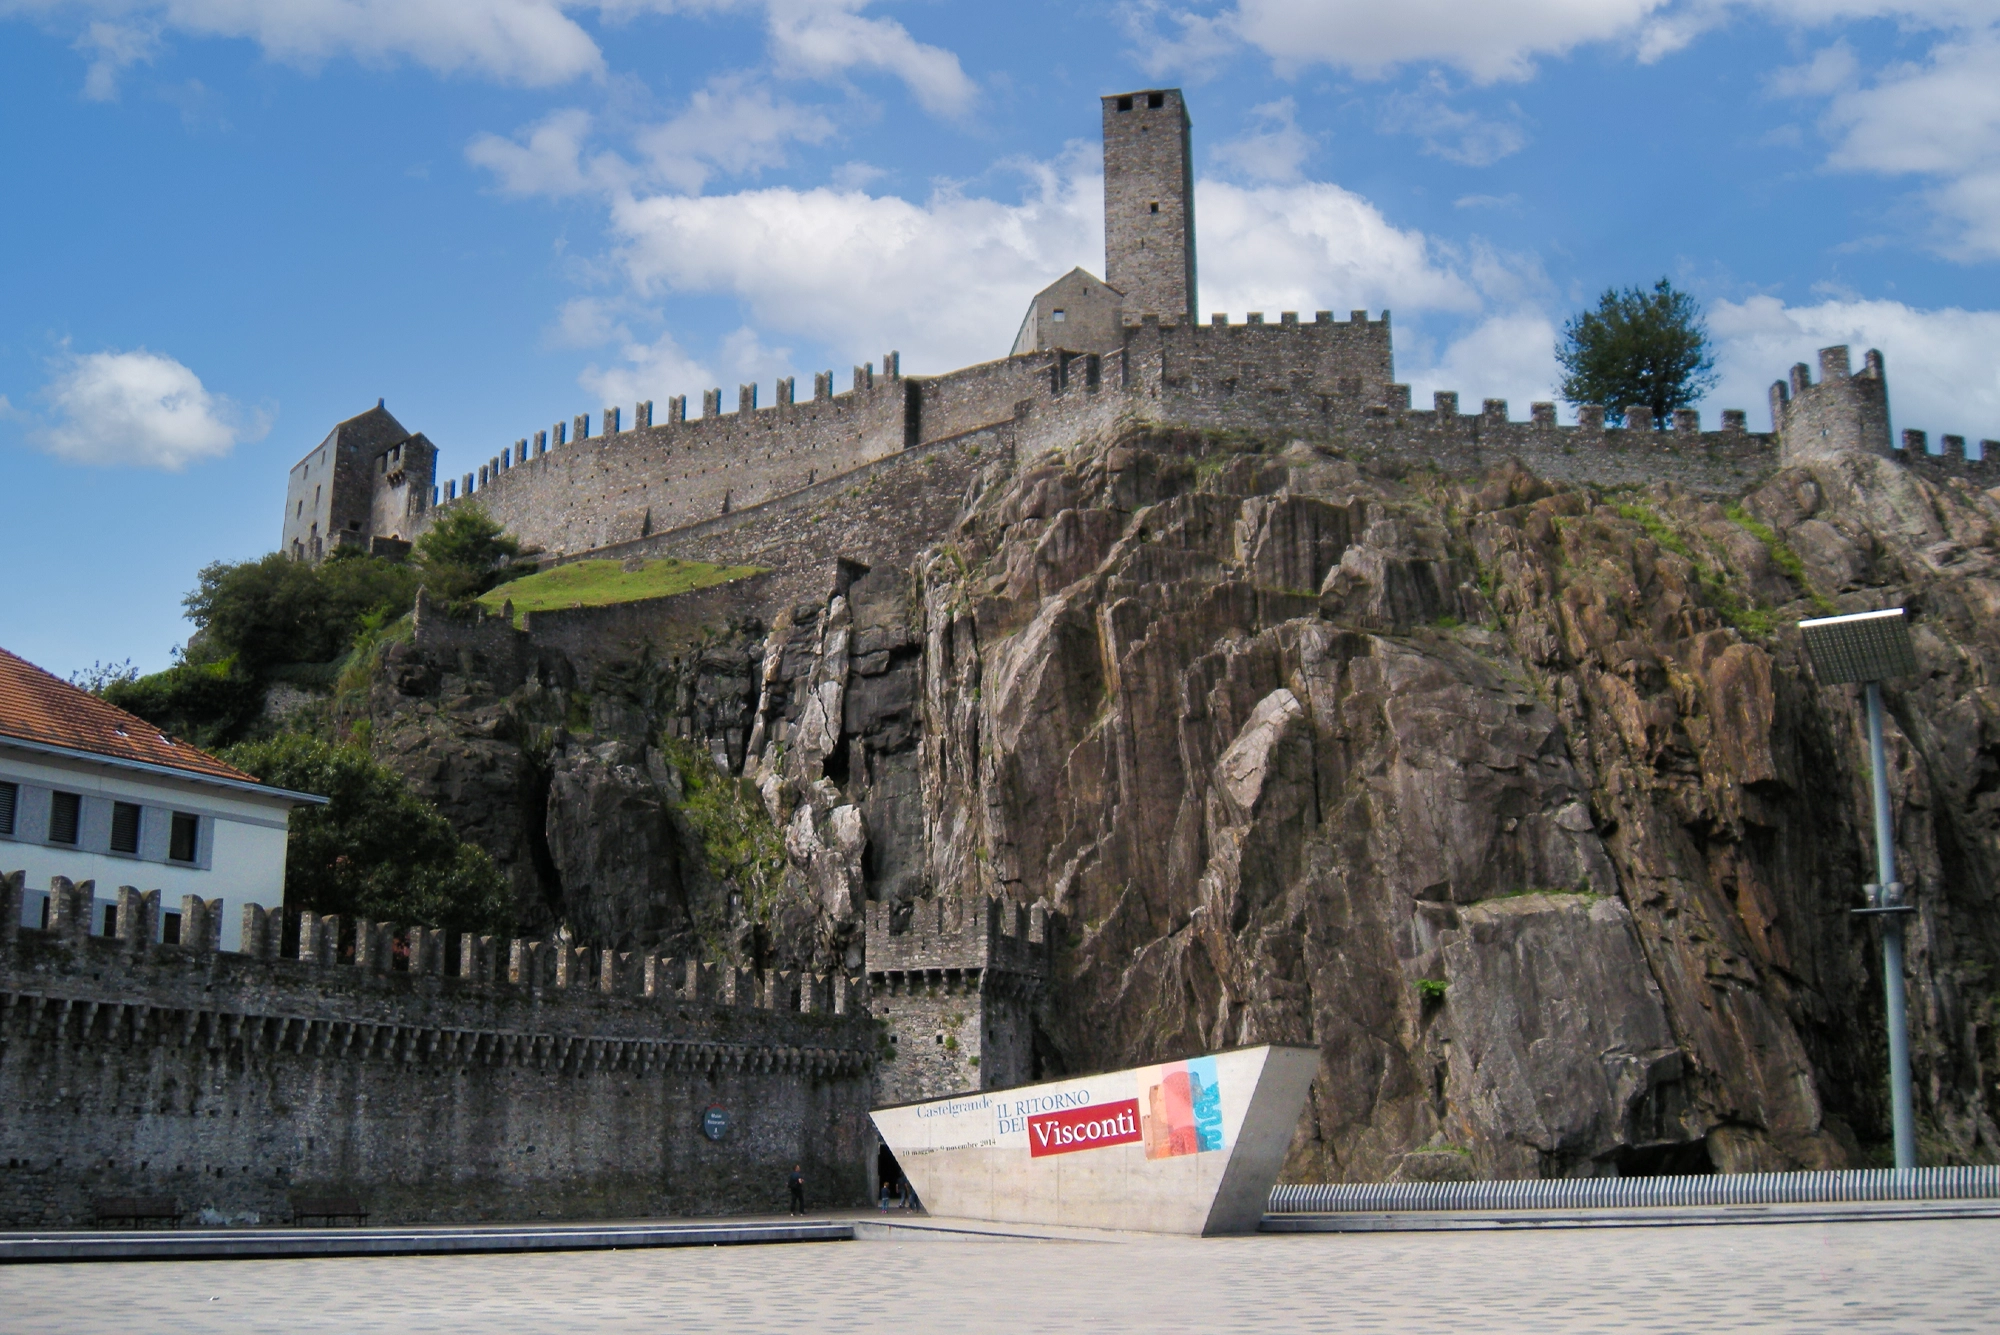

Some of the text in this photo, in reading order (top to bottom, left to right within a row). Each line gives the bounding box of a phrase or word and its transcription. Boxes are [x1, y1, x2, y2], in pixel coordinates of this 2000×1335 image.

[917, 1096, 993, 1118] Castelgrande
[997, 1090, 1090, 1118] IL RITORNO
[999, 1117, 1025, 1135] DEI
[1033, 1109, 1137, 1148] Visconti
[946, 1142, 979, 1151] novembre
[980, 1138, 996, 1148] 2014
